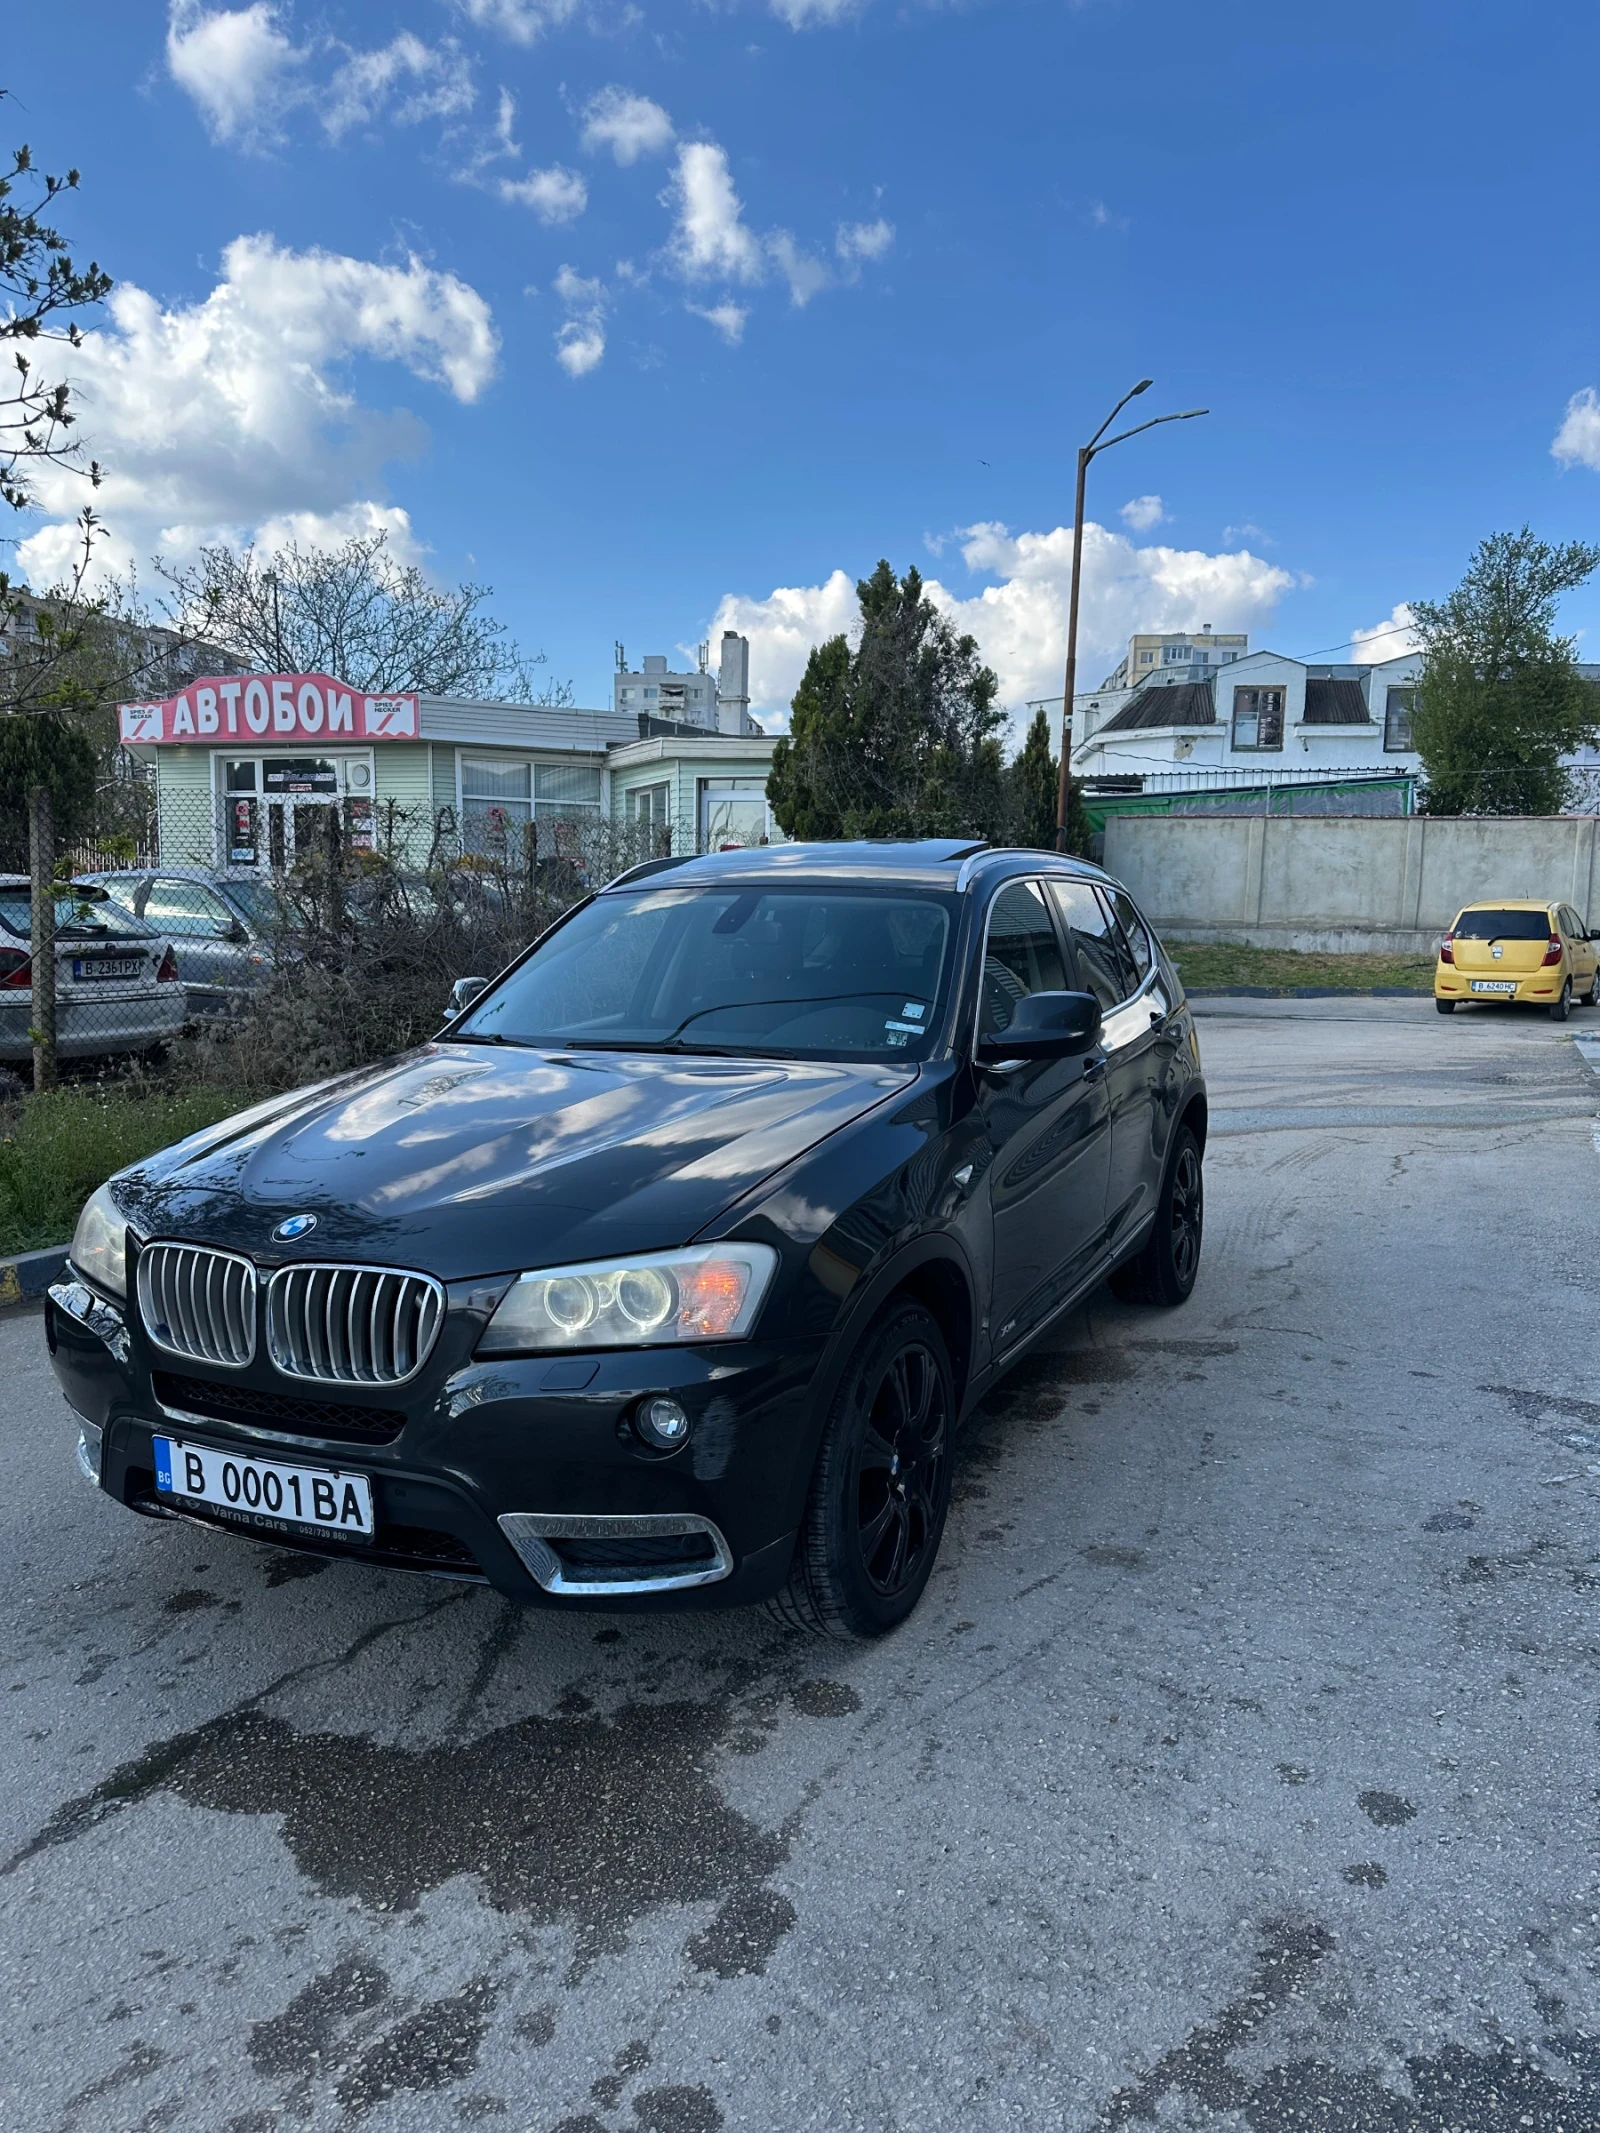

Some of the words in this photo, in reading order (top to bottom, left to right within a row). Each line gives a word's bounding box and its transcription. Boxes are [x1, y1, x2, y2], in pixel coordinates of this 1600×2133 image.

[173, 679, 353, 734] АВТОБОИ
[85, 962, 93, 975] B
[158, 1471, 171, 1485] BG
[185, 1451, 206, 1494] B
[211, 1503, 250, 1522] Varna
[254, 1514, 288, 1532] Cars
